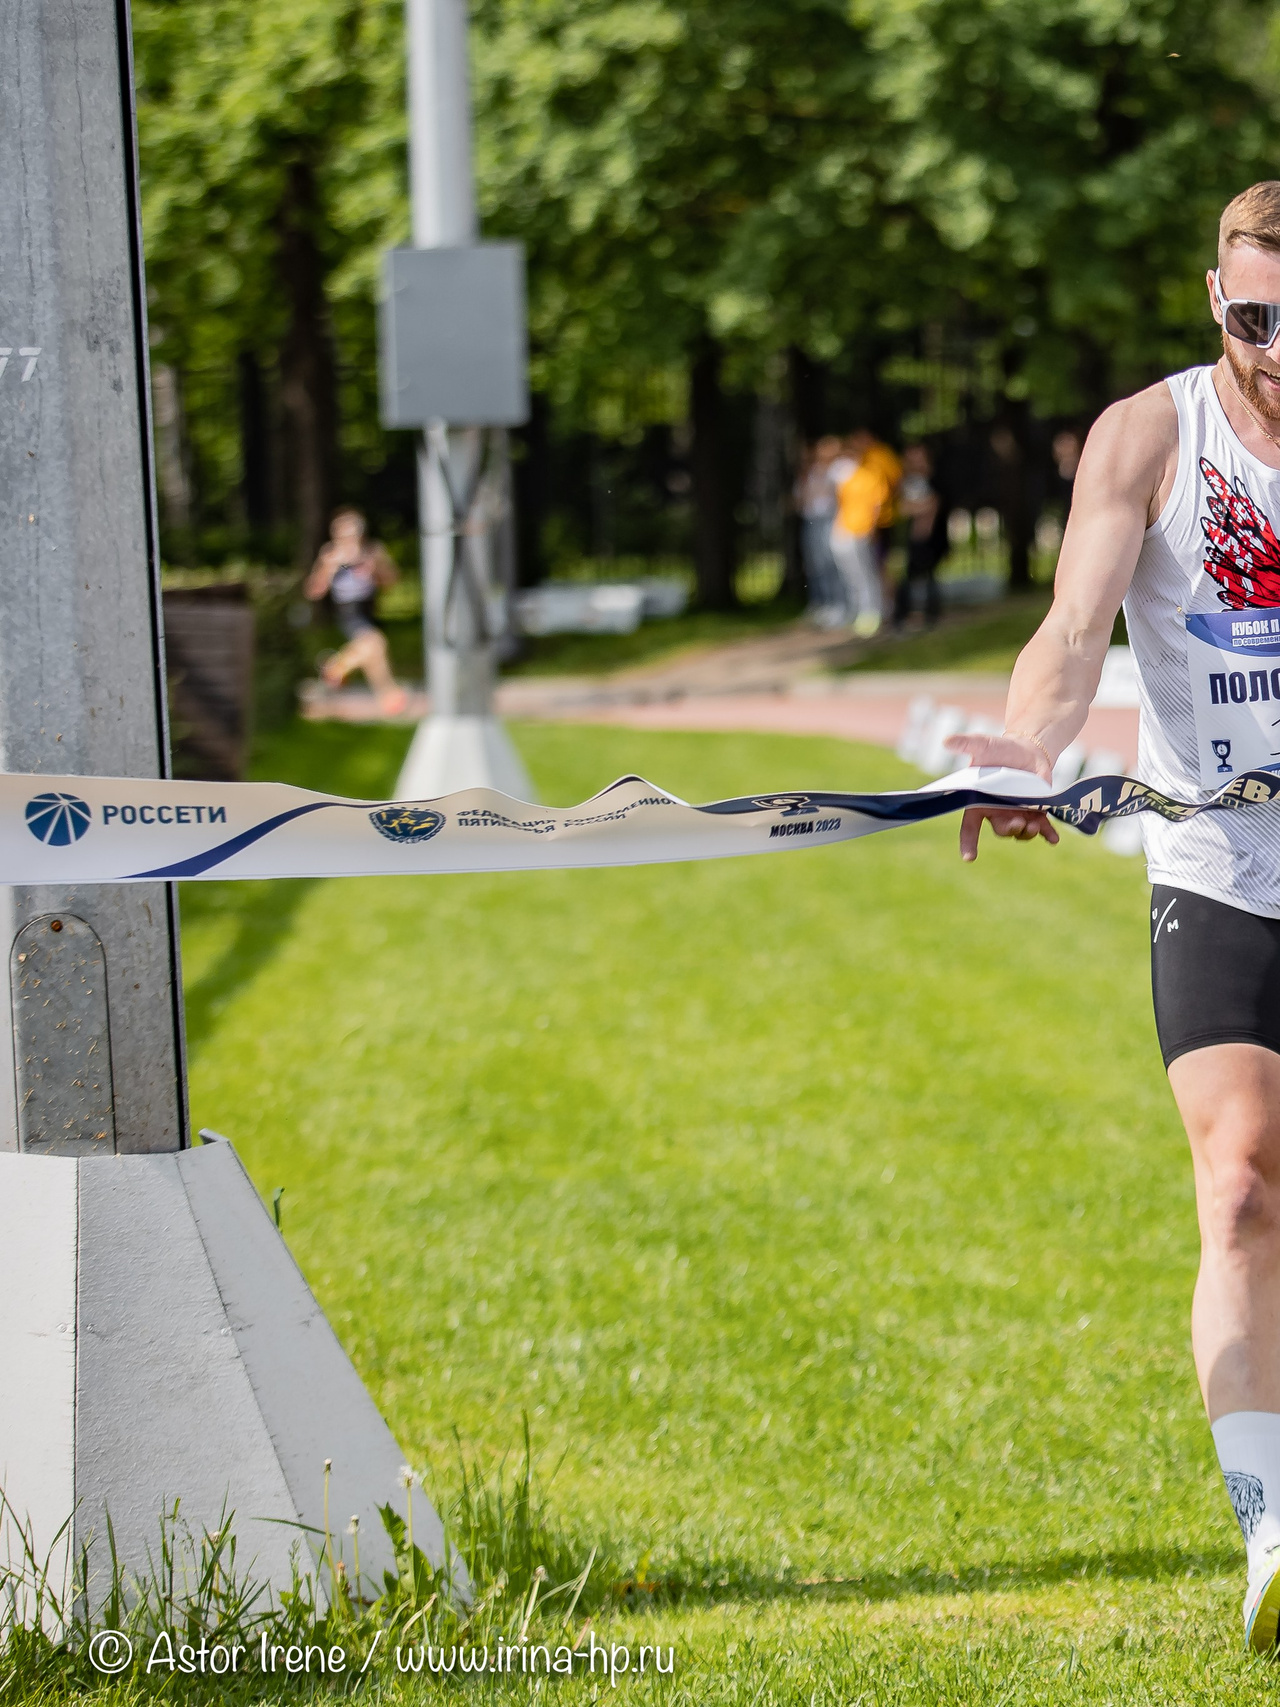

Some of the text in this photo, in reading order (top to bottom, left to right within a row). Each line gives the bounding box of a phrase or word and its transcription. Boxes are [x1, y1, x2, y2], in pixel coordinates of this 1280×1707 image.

[1230, 619, 1270, 637] КУБОК
[102, 804, 228, 826] РОССЕТИ
[768, 817, 842, 839] МОСКВА 2023
